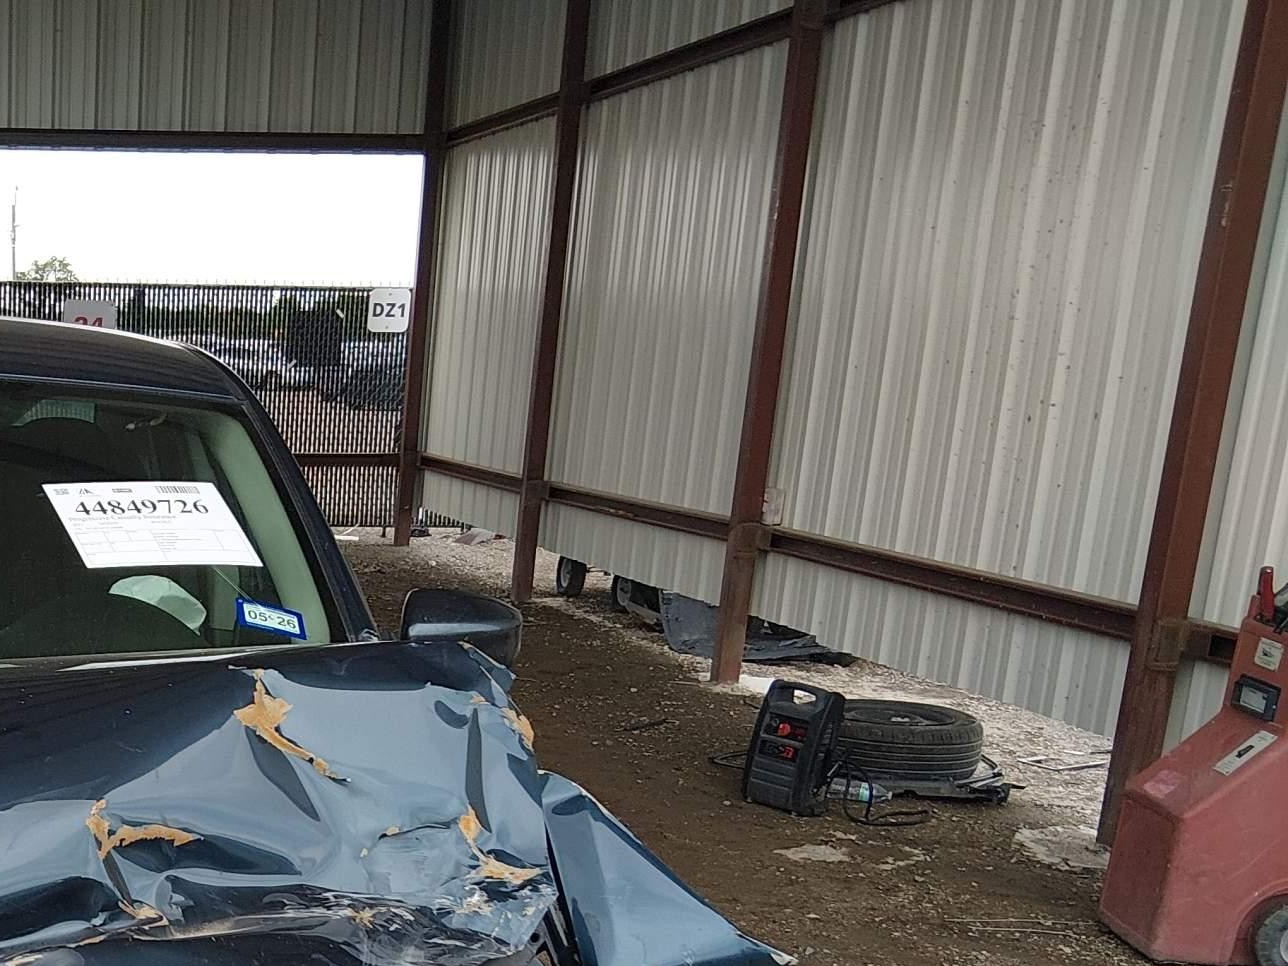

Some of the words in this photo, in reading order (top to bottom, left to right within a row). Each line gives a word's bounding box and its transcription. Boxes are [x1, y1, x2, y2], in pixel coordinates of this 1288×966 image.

[372, 302, 406, 318] DZ1
[75, 499, 209, 516] 44849726
[248, 610, 268, 622] 05
[276, 616, 296, 629] 26
